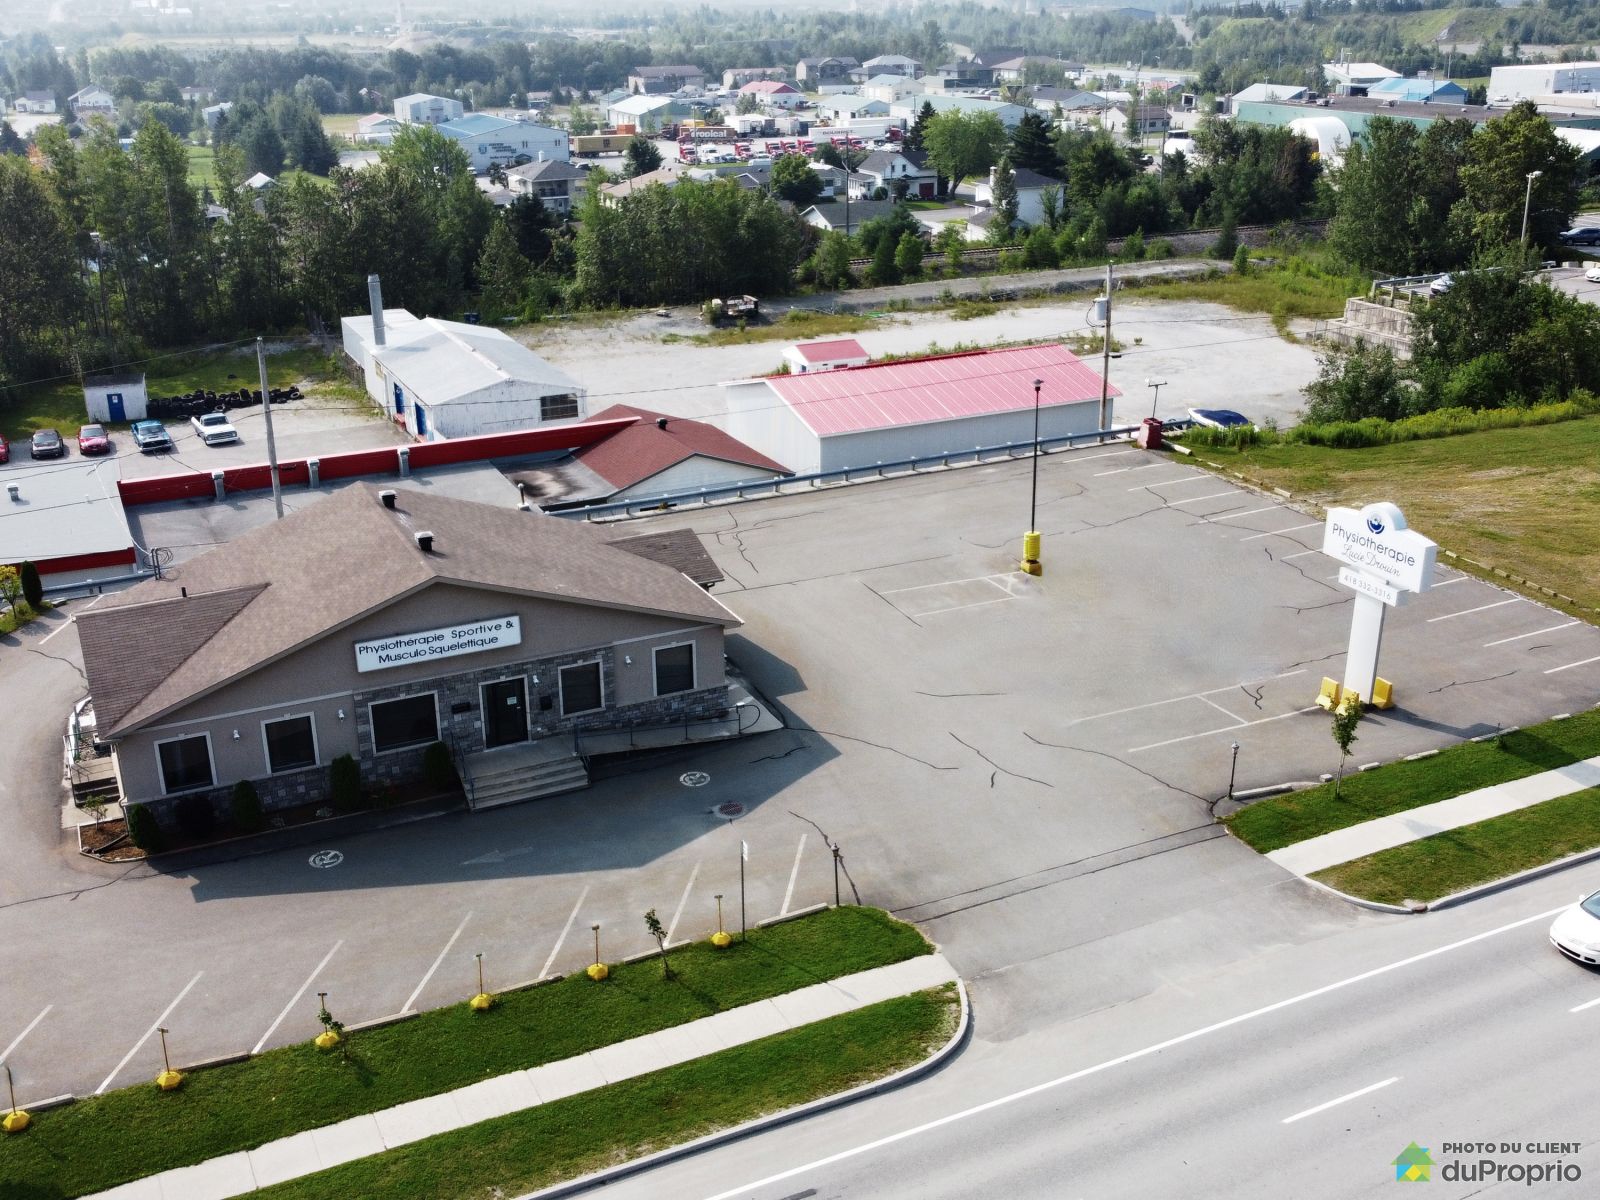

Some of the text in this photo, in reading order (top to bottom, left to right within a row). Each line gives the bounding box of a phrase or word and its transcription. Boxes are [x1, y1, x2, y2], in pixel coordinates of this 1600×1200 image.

[1343, 574, 1357, 585] 418
[451, 623, 502, 640] Sportive
[505, 620, 514, 629] &
[378, 635, 499, 664] Musculo Squelettique
